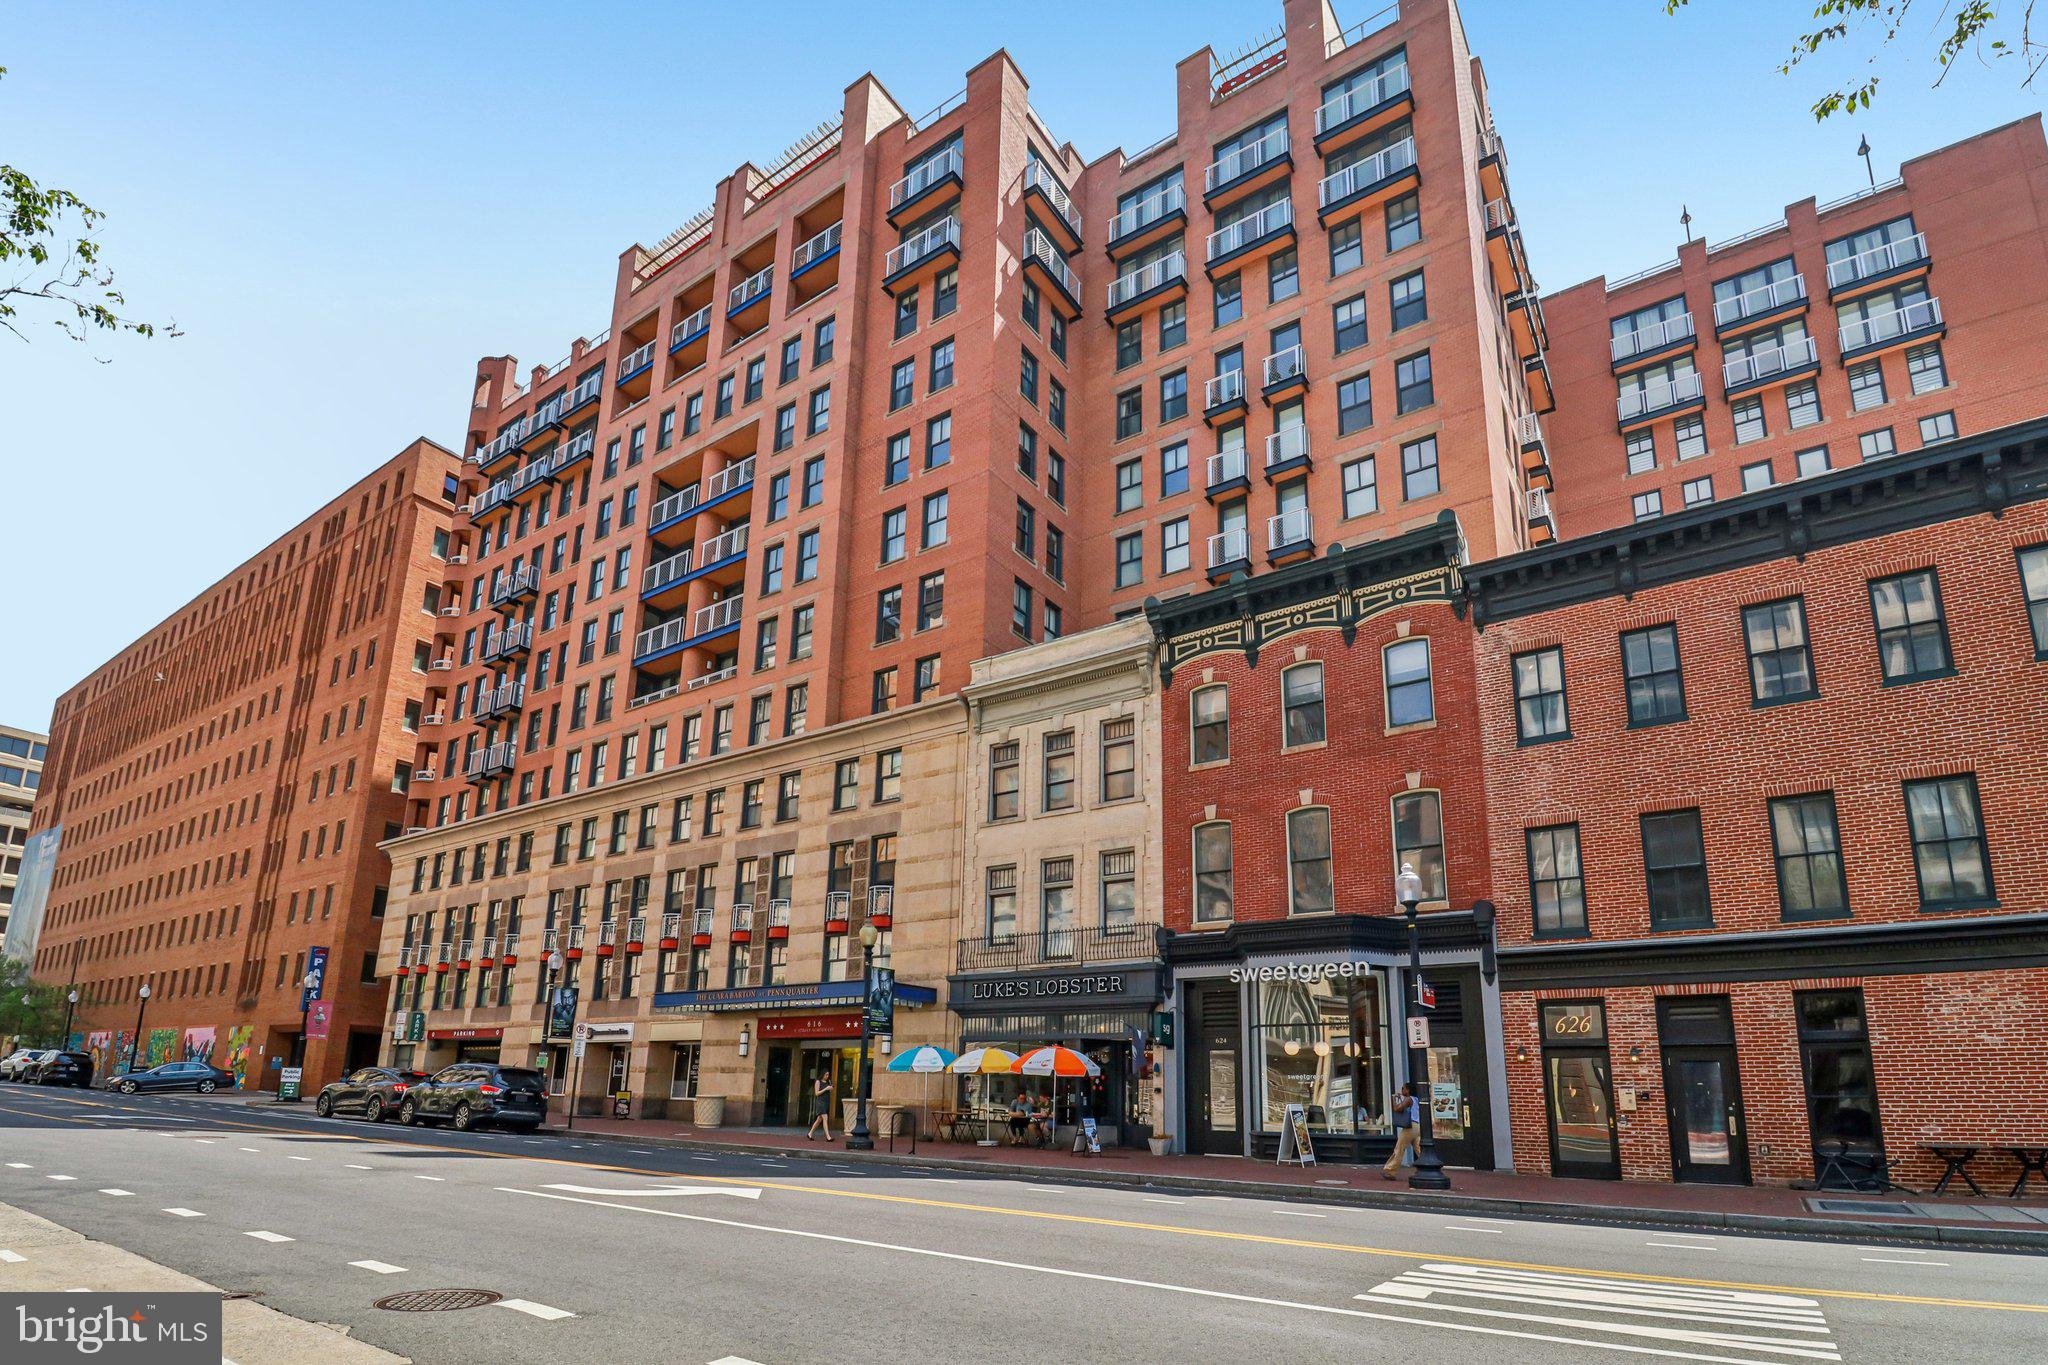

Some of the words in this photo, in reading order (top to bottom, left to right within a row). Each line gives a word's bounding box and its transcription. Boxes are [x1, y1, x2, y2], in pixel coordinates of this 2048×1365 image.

[1230, 960, 1370, 983] sweetgreen
[708, 991, 729, 1000] CLARA
[729, 989, 756, 999] BARTON
[767, 988, 785, 997] PENN
[786, 986, 819, 996] QUARTER
[973, 981, 1029, 999] LUKE'S
[1035, 976, 1123, 995] LOBSTER
[807, 1020, 822, 1028] 616
[1163, 1024, 1171, 1035] sg
[1555, 1015, 1591, 1034] 626
